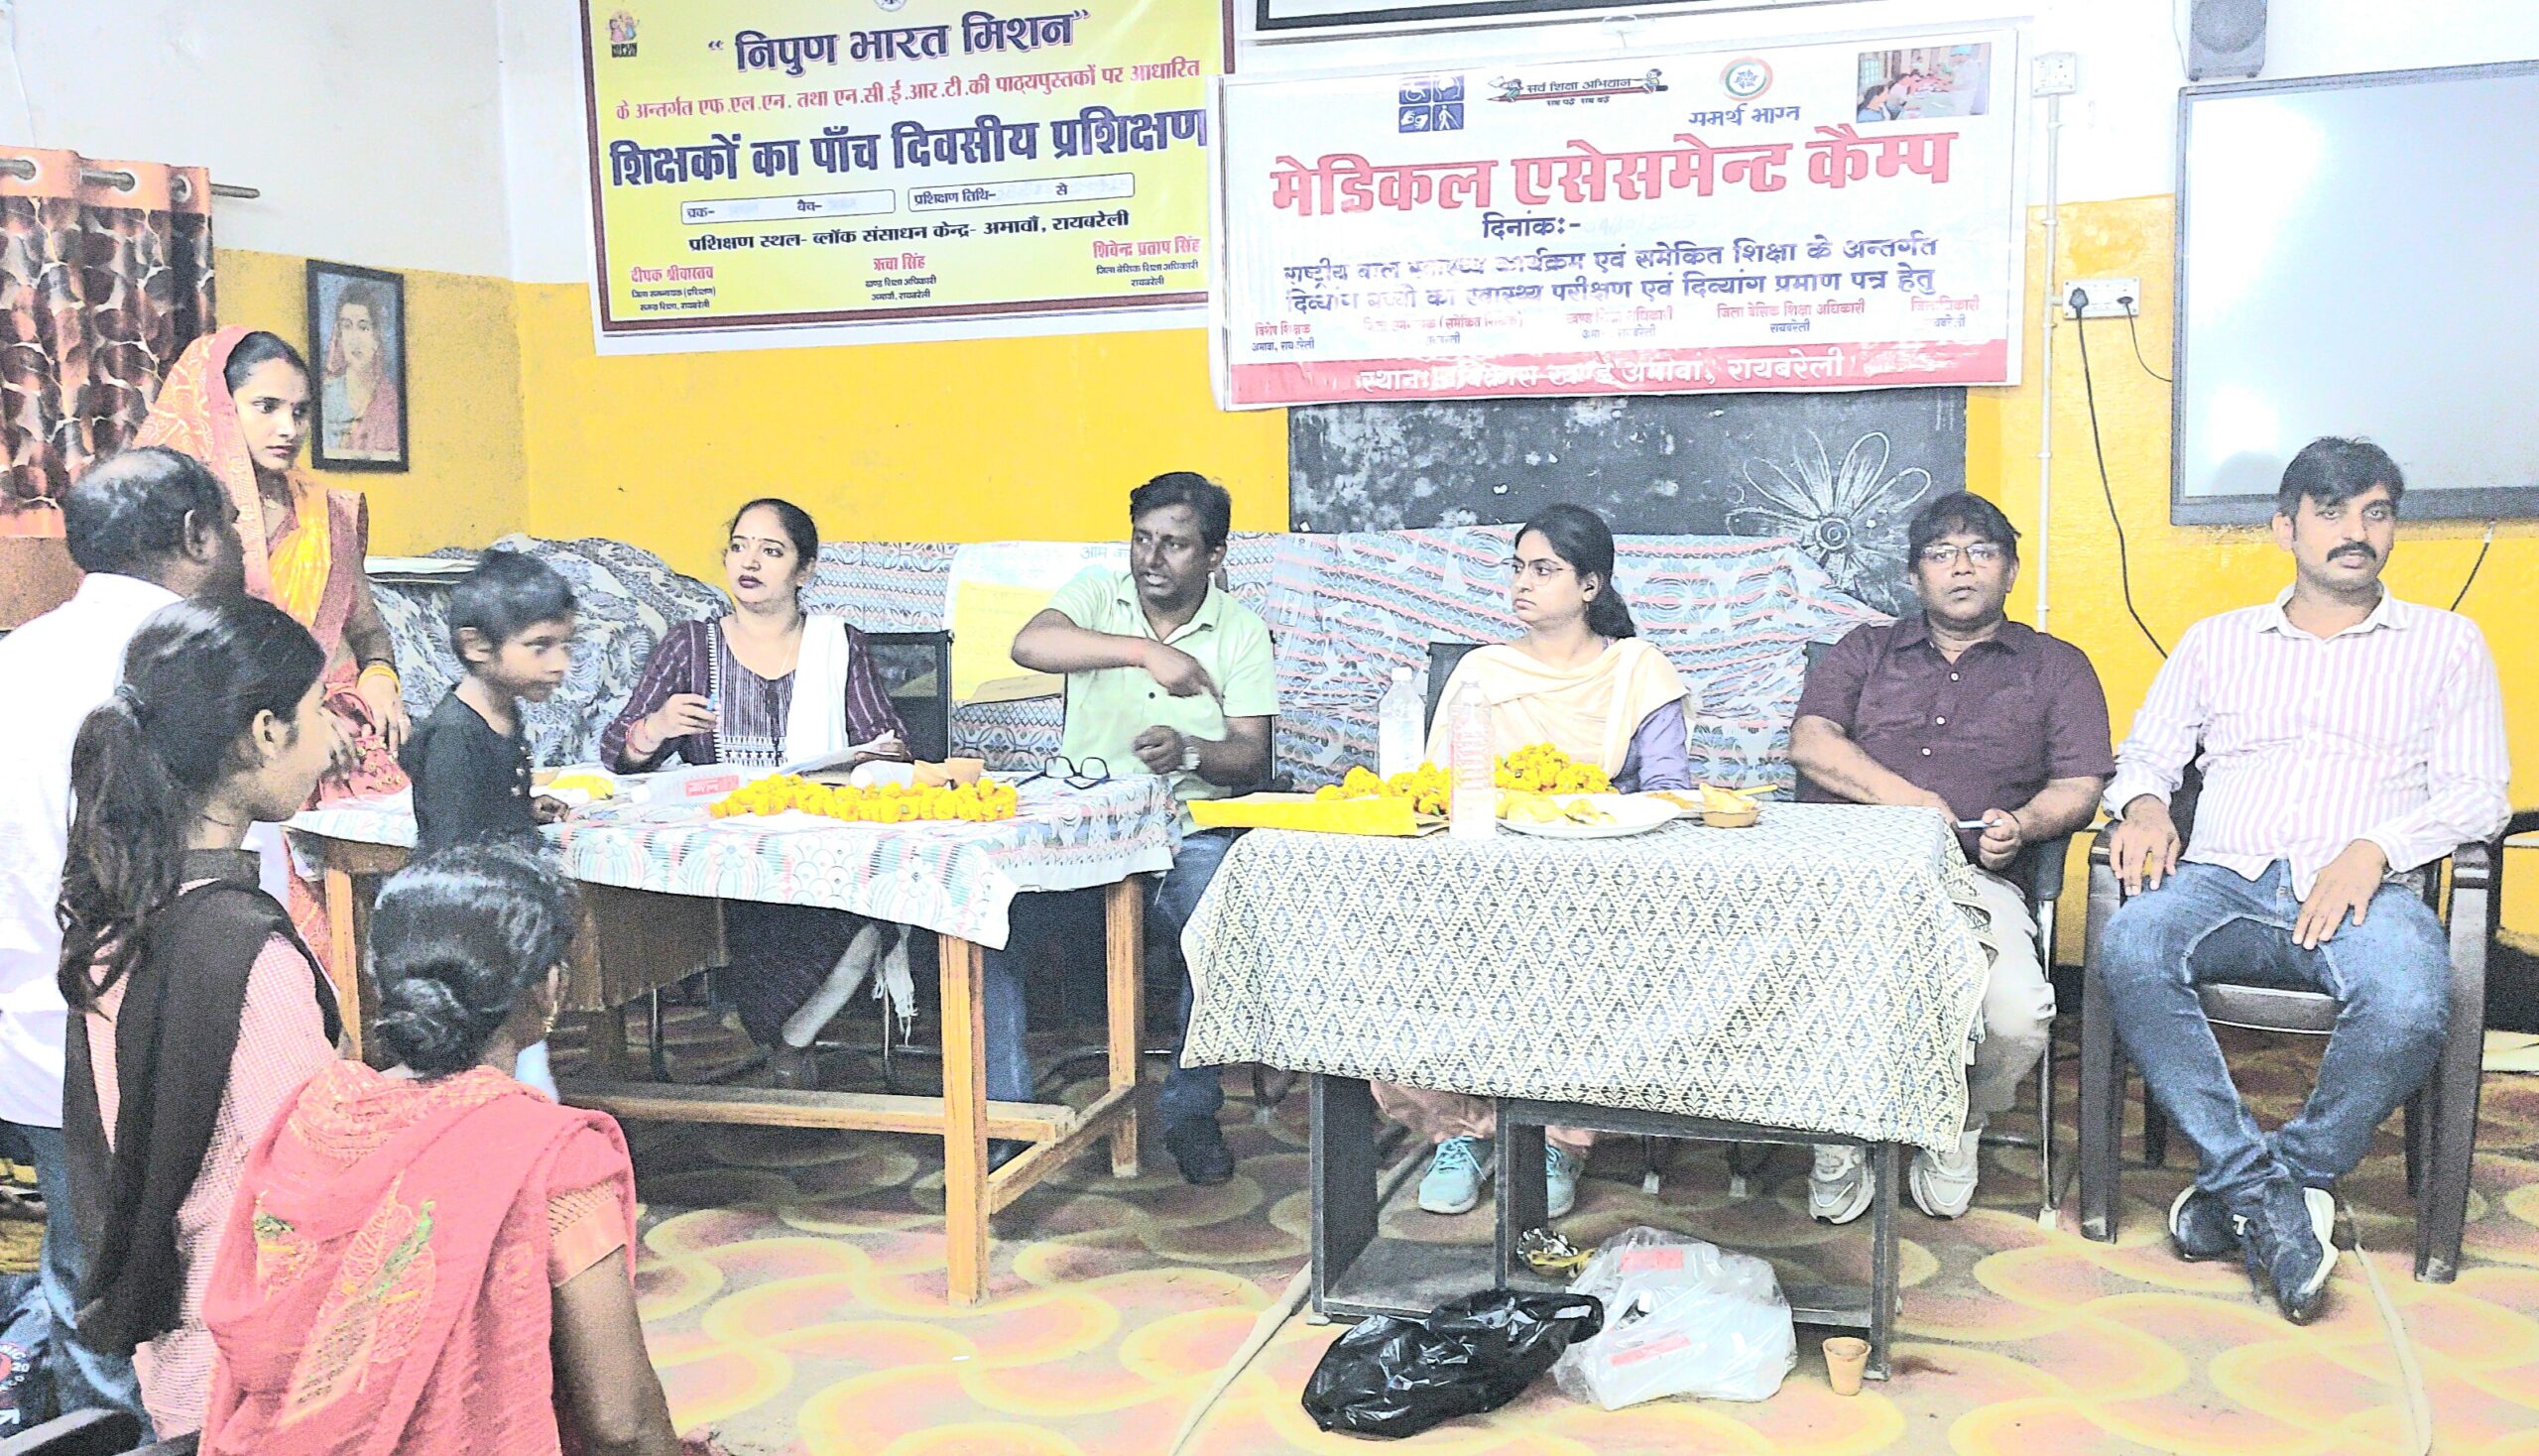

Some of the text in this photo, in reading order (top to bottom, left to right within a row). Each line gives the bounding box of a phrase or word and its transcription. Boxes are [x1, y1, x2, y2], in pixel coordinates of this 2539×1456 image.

[735, 31, 837, 76] निपुण
[850, 26, 950, 61] भारत
[616, 100, 630, 120] के
[636, 96, 693, 119] अन्तर्गत
[796, 90, 829, 108] तथा
[996, 63, 1096, 95] पाठ्यपुस्तकों
[1102, 66, 1125, 84] पर
[1130, 57, 1200, 81] आधारित
[609, 133, 741, 186] शिक्षकों
[750, 139, 799, 177] का
[891, 114, 1039, 169] दिवसीय
[1049, 105, 1207, 160] प्रशिक्षण
[1270, 122, 1960, 216] मेडिकल एसेसमेन्ट कैम्प
[913, 189, 959, 206] प्रशिक्षण
[1055, 182, 1068, 196] से
[688, 234, 754, 252] प्रशिक्षण
[812, 227, 857, 245] ब्लॉक
[862, 224, 927, 242] संसाधन
[1051, 208, 1130, 231] रायबरेली
[1138, 240, 1171, 257] प्रताप
[1174, 235, 1201, 254] सिंह
[1593, 243, 1628, 274] एवं
[1634, 240, 1726, 269] समेकित
[1733, 237, 1798, 264] शिक्षा
[1806, 234, 1833, 260] के
[1843, 229, 1939, 259] अन्तर्गत
[902, 252, 926, 270] सिंह
[1163, 258, 1198, 271] अधिकारी
[631, 264, 714, 283] दीपक श्रीवास्तव
[1131, 275, 1164, 287] रायबरेली
[1551, 275, 1633, 302] परीक्षण
[1641, 271, 1674, 302] एवं
[1683, 269, 1767, 299] दिव्यांग
[1774, 273, 1842, 294] प्रमाण
[1851, 271, 1888, 290] पत्र
[1896, 262, 1937, 295] हेतु
[899, 288, 930, 300] रायबरेली
[1717, 299, 1865, 319] जिला बेसिक शिक्षा अधिकारी
[1770, 318, 1810, 333] रायबरेली
[1727, 347, 1845, 381] रायबरेली
